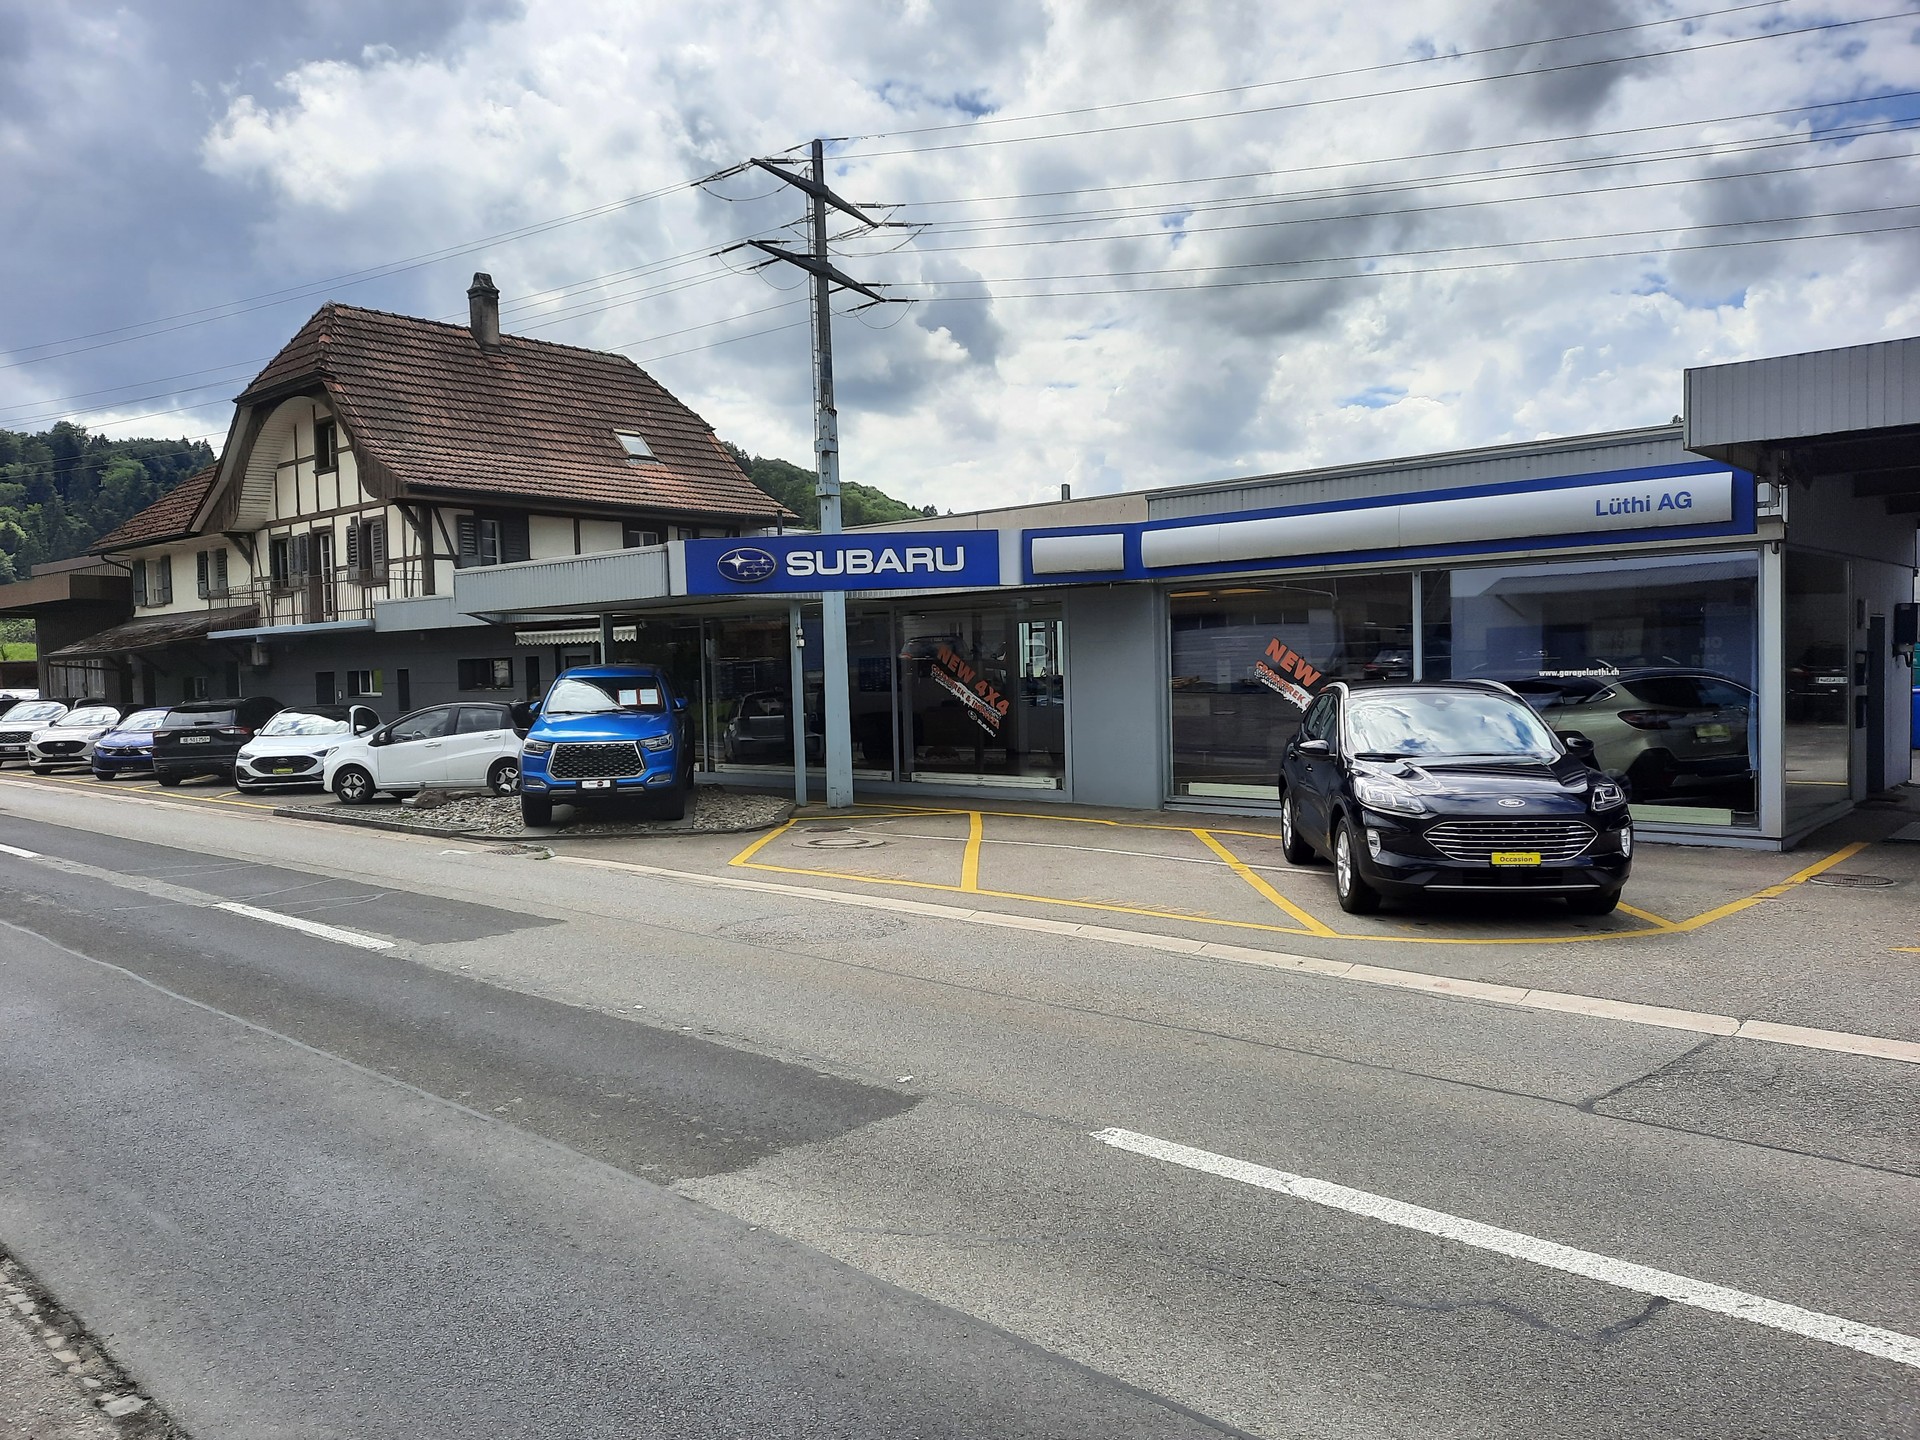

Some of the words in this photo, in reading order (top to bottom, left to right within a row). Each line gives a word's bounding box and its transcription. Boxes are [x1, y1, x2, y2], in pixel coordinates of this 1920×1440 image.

[1596, 495, 1651, 516] Lüthi
[1657, 491, 1692, 511] AG
[785, 546, 965, 576] SUBARU
[937, 643, 977, 684] NEW
[1264, 637, 1322, 688] NEW
[1538, 667, 1620, 678] www.garageluethi.ch
